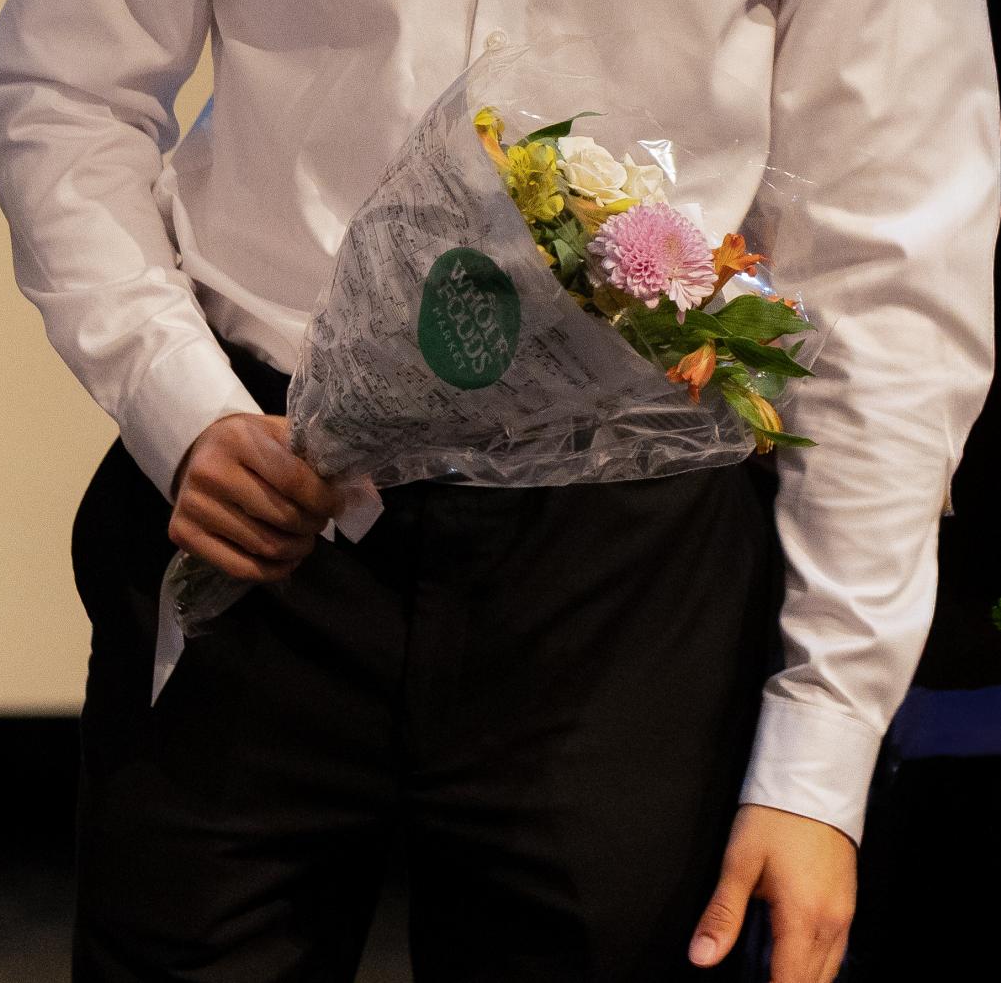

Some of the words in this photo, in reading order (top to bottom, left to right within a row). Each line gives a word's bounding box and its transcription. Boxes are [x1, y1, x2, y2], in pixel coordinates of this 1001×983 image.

[432, 307, 466, 370] MARKET
[438, 280, 493, 373] FOODS
[450, 258, 508, 355] WHOLE
